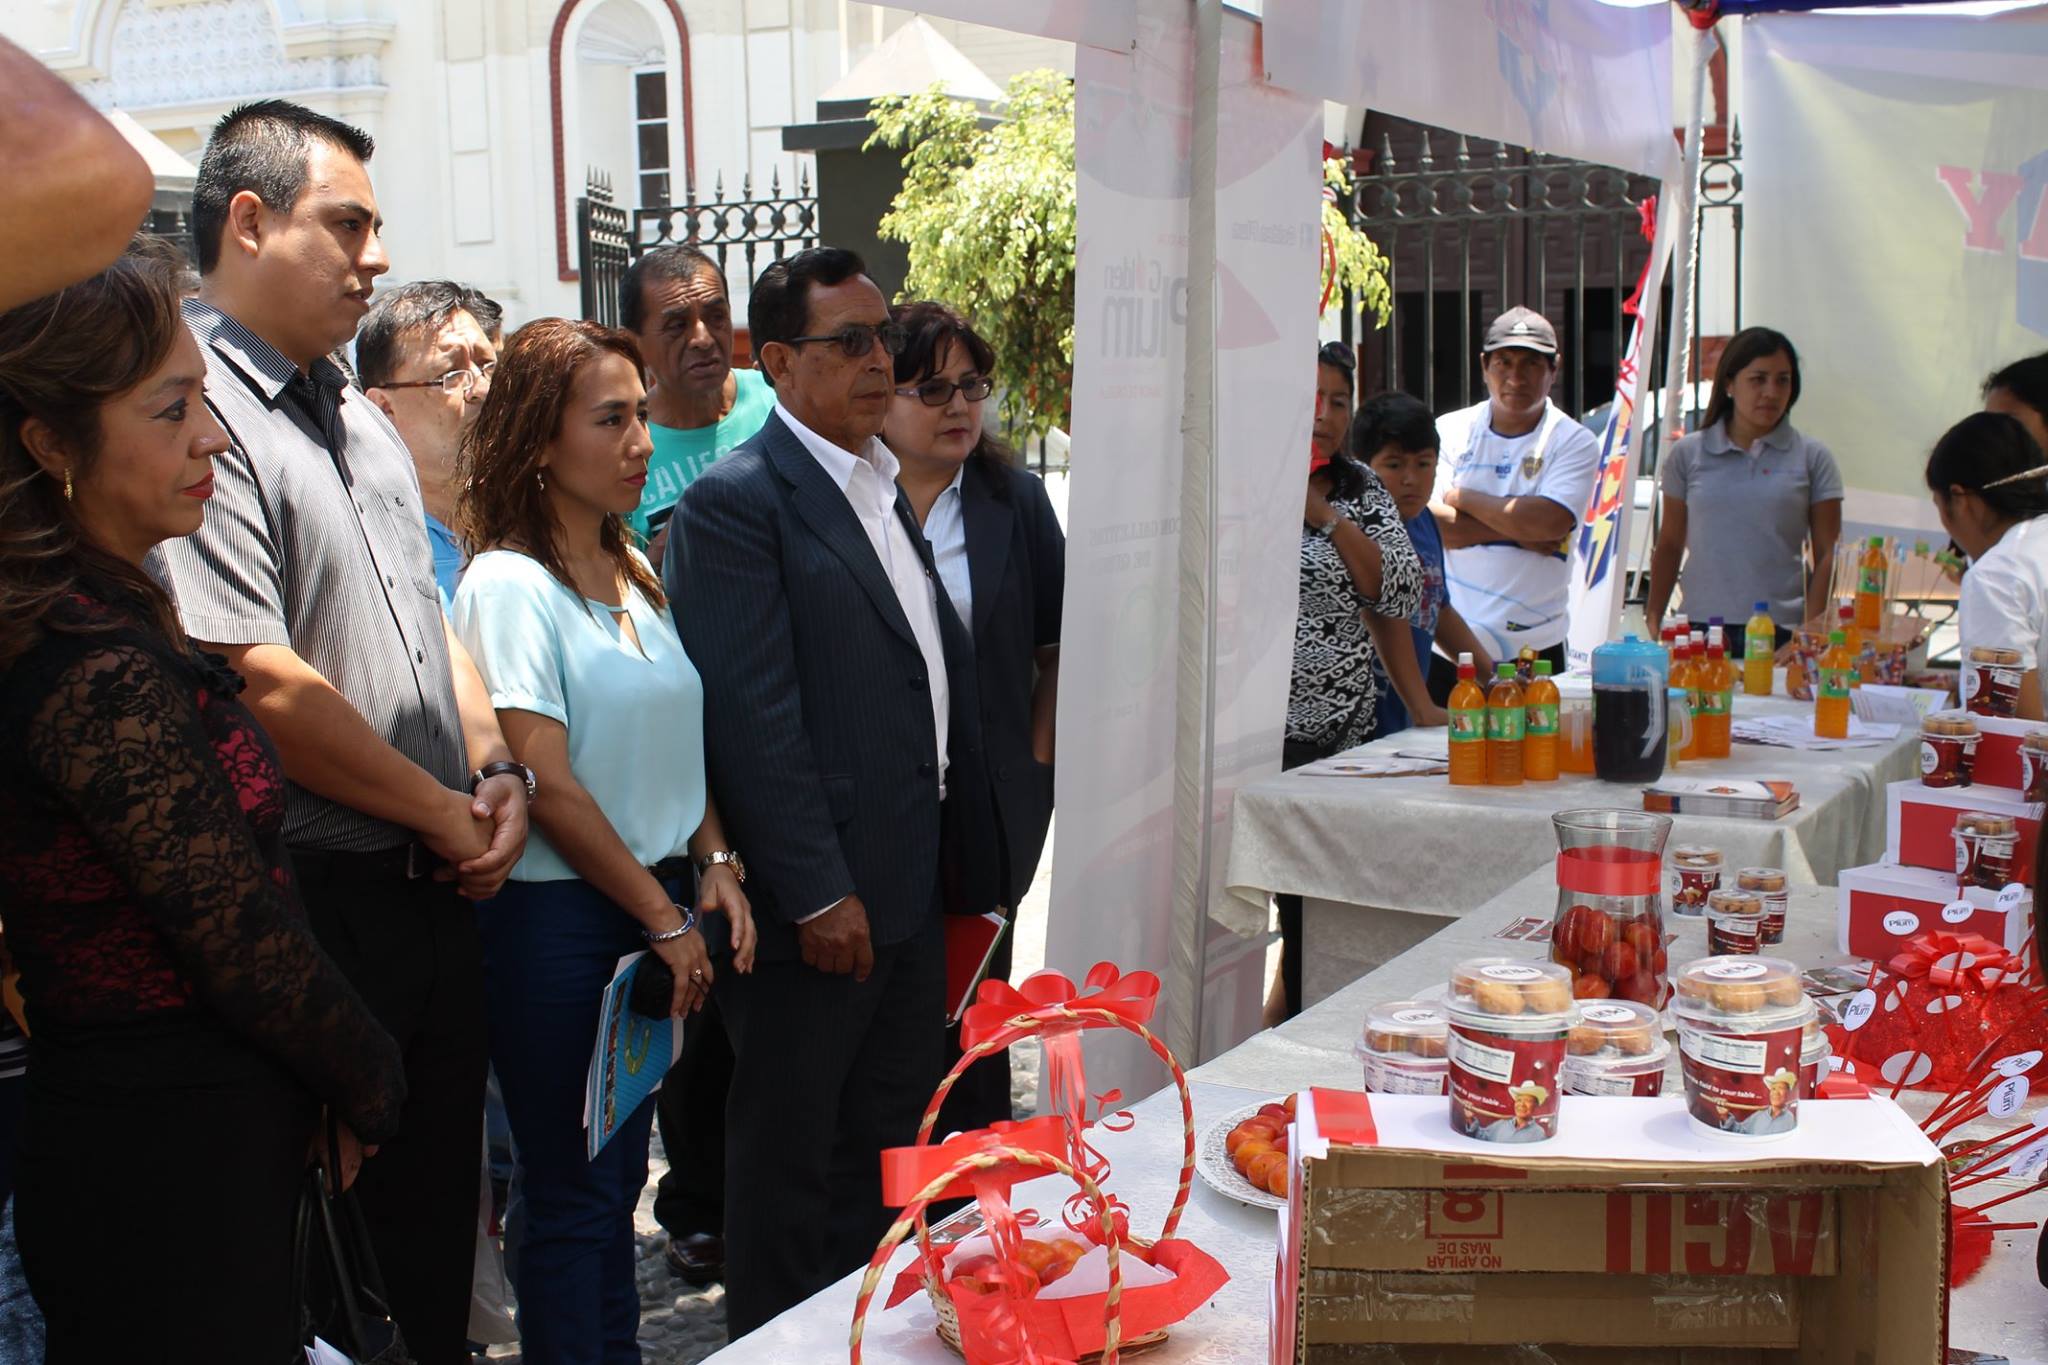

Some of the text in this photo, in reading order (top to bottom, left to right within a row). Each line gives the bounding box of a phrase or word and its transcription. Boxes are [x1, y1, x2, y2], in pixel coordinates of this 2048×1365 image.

[1848, 1005, 1870, 1016] Plum
[2003, 1081, 2016, 1112] Plum
[1437, 1242, 1491, 1255] MAS DE
[1426, 1255, 1502, 1269] NO APILAR
